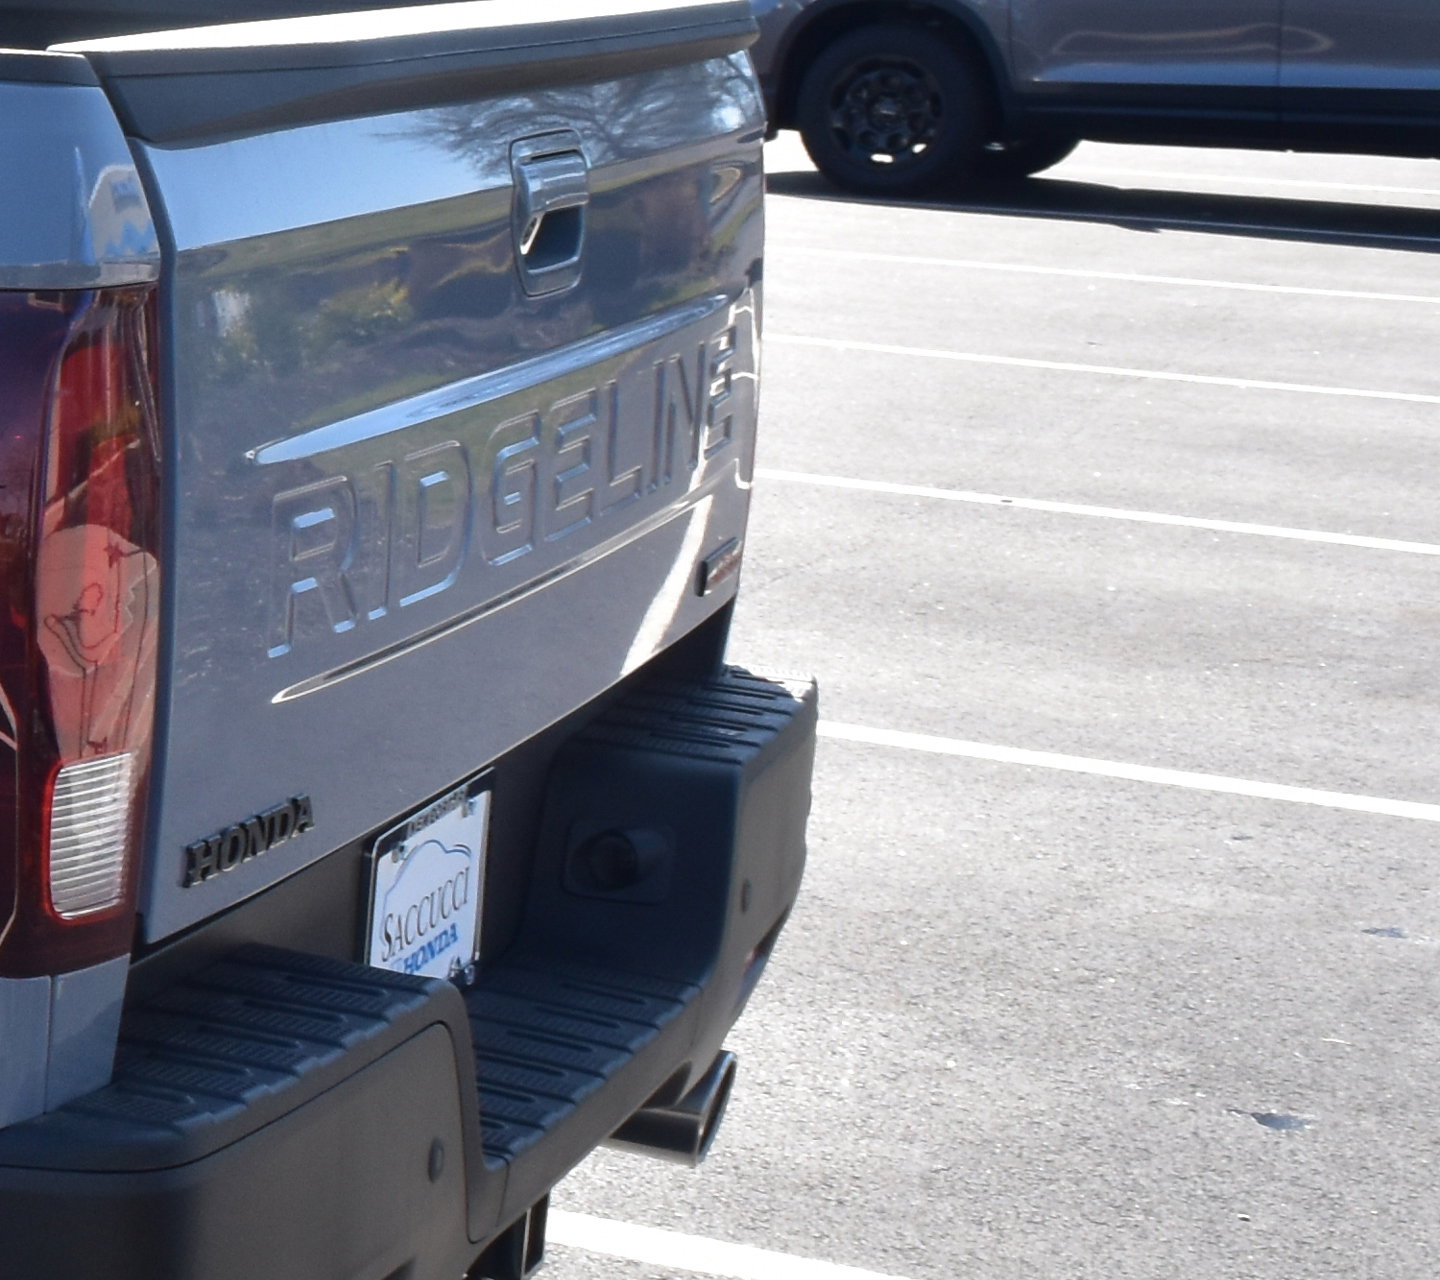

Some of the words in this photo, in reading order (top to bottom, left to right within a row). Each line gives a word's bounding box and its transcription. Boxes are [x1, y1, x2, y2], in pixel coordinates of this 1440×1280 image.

[266, 323, 739, 660] RIDGELINE
[180, 793, 314, 888] HONDA
[382, 866, 471, 963] SACCUCCI
[403, 922, 459, 975] HONDA
